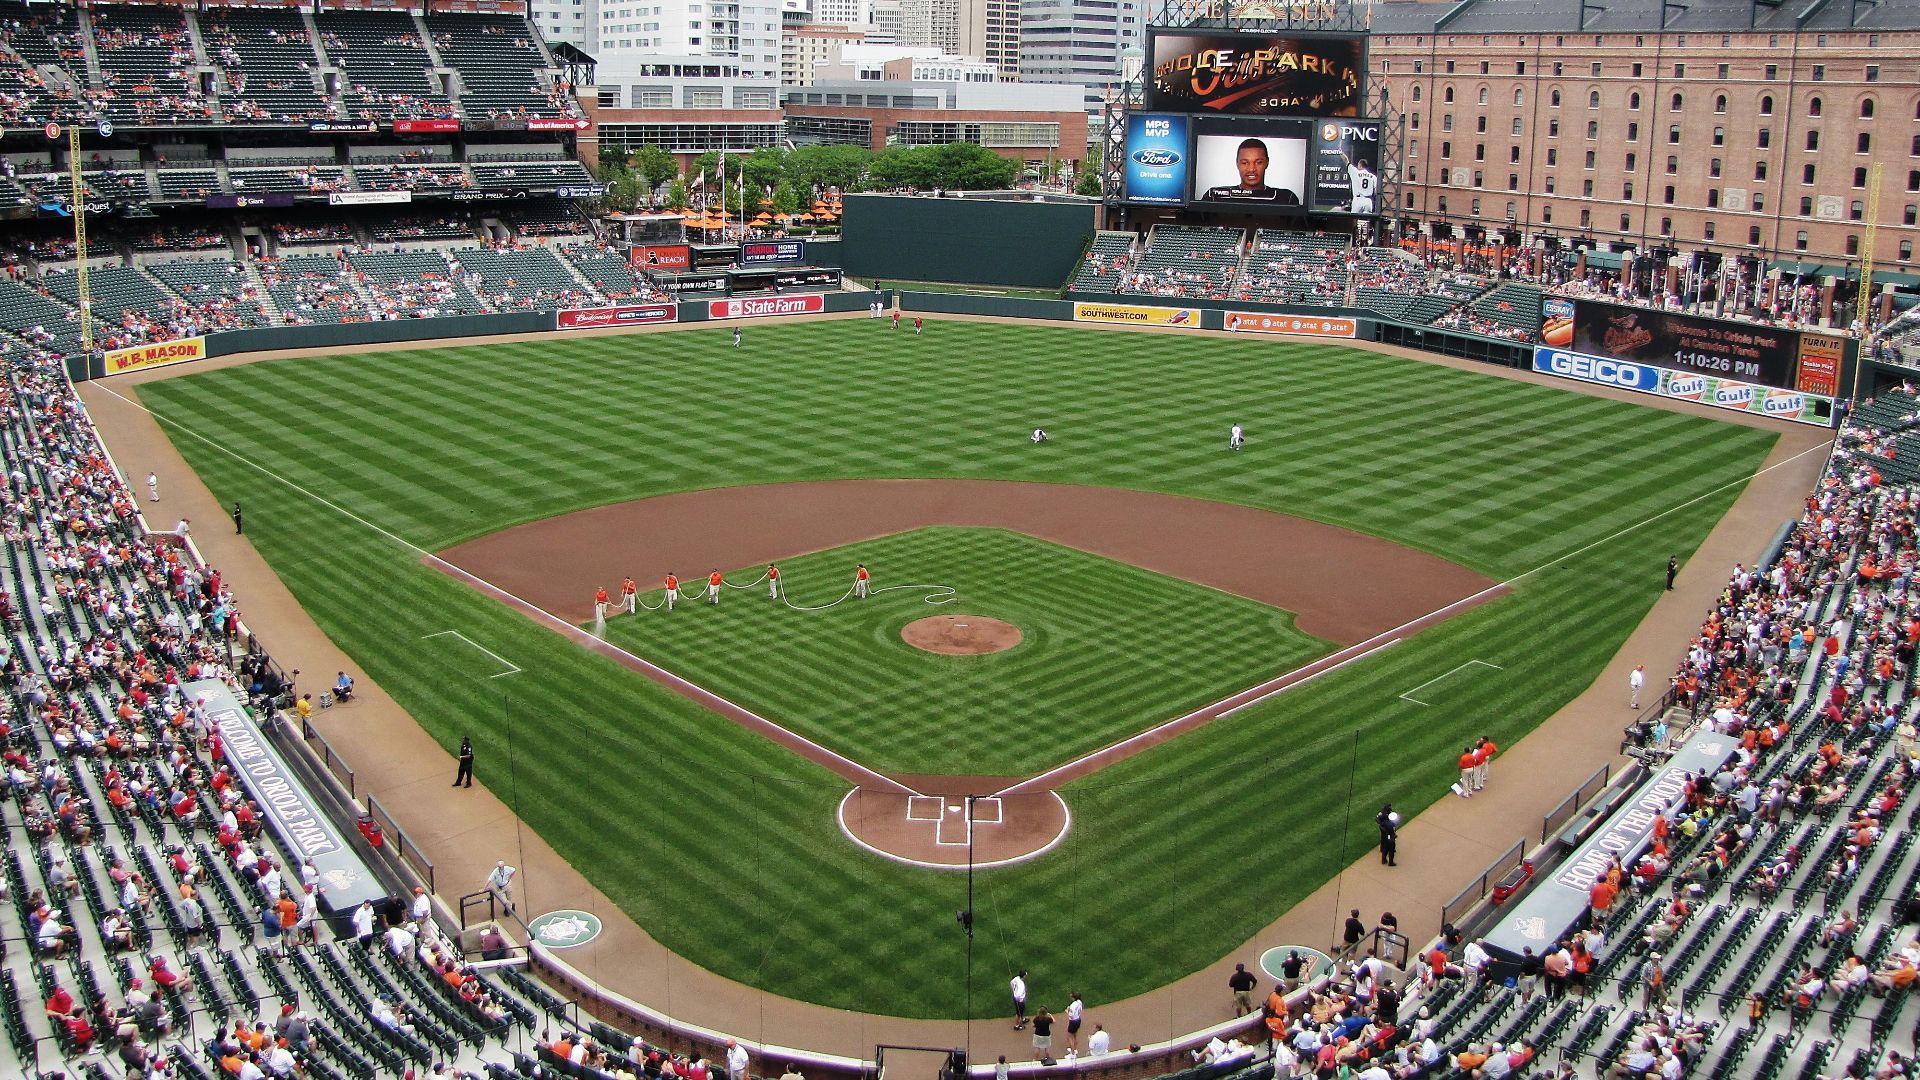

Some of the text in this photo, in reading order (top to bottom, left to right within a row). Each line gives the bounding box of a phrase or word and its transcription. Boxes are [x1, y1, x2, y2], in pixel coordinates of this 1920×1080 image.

[1254, 50, 1336, 76] PARK
[51, 126, 56, 135] 8
[1145, 119, 1170, 129] MPG
[1145, 129, 1170, 138] MVP
[1341, 126, 1378, 141] PNC
[1141, 149, 1172, 164] Ford
[1361, 178, 1369, 189] 8
[331, 194, 344, 204] UA
[660, 256, 685, 264] REACH
[667, 282, 681, 290] YOUR
[1081, 310, 1148, 321] SOUTHWEST.COM
[1545, 302, 1571, 314] ESSKAY
[1803, 337, 1840, 350] TURN IT.
[115, 345, 198, 370] W.B. MASON
[1674, 350, 1760, 377] 1:10:26 PM
[1551, 353, 1640, 386] GEICO
[1669, 378, 1704, 395] Gulf
[1715, 388, 1752, 404] Gulf
[1763, 396, 1803, 412] Gulf
[217, 708, 335, 855] WELCOME TO ORIOLE PARK
[1599, 829, 1632, 852] OF
[1617, 809, 1653, 836] THE
[1638, 767, 1686, 818] ORIOLES
